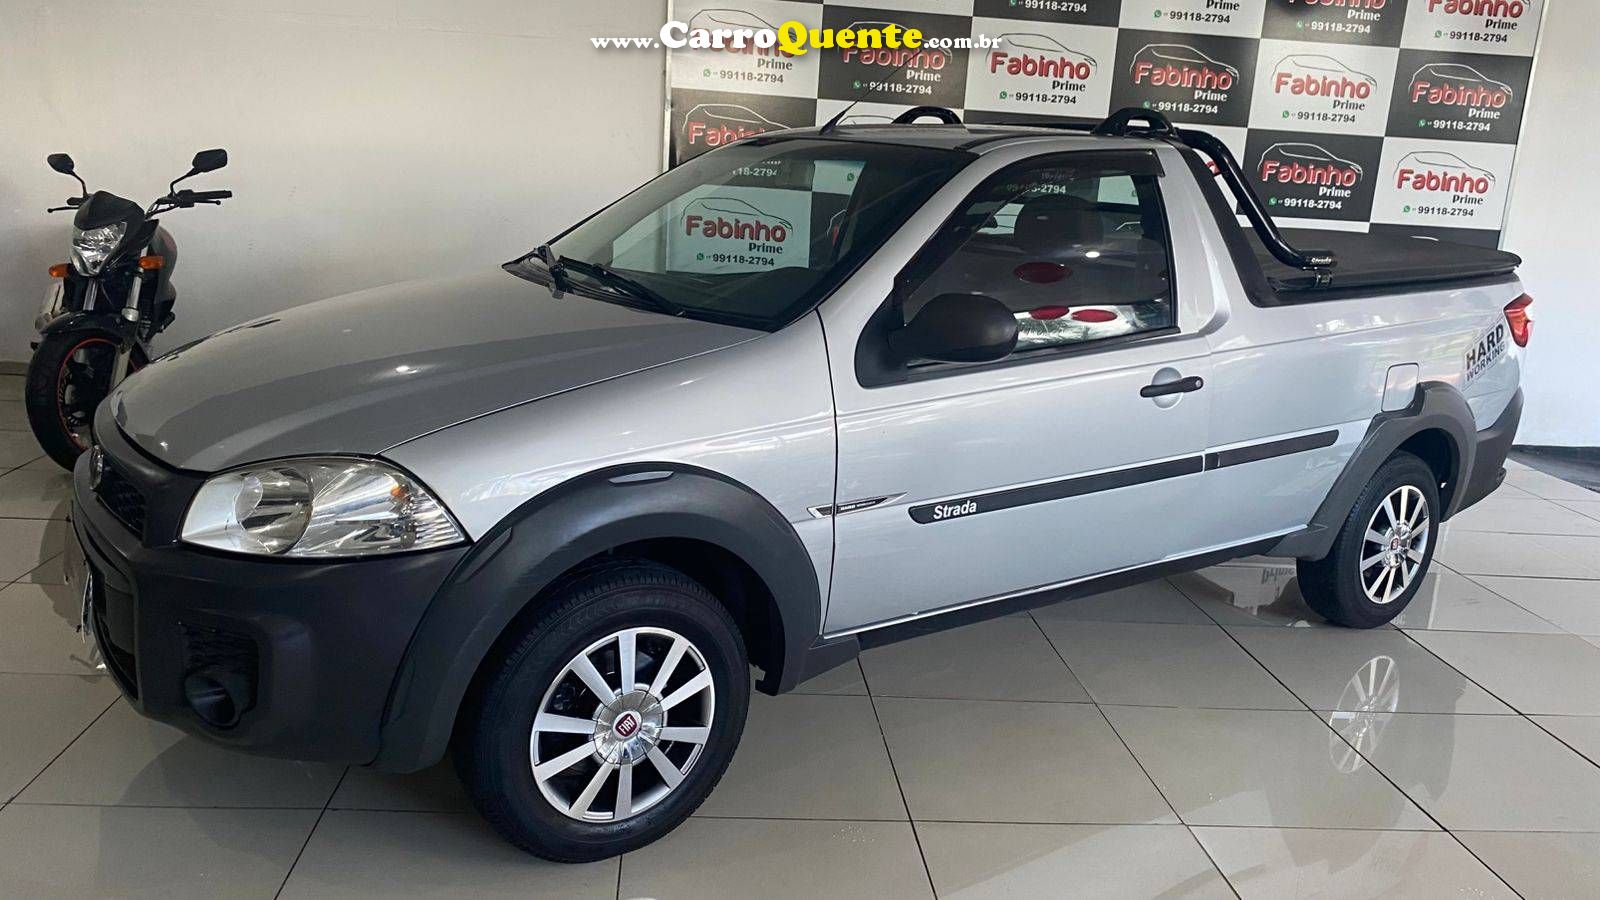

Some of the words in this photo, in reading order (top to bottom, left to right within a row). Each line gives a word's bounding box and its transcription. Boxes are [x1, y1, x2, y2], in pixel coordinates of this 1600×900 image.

[1025, 0, 1087, 13] 99118-2794
[1169, 11, 1231, 23] 99118-2794
[1347, 9, 1381, 21] Prime
[1311, 21, 1371, 33] 99118-2794
[1485, 19, 1518, 30] Prime
[1449, 31, 1508, 42] 99118-2794
[757, 58, 793, 70] Prime
[990, 51, 1091, 80] Fabinho
[719, 70, 784, 83] 99118-2794
[906, 69, 942, 82] Prime
[1134, 61, 1233, 90] Fabinho
[869, 82, 932, 95] 99118-2794
[1052, 80, 1086, 92] Prime
[1274, 72, 1371, 99] Fabinho
[1015, 92, 1077, 105] 99118-2794
[1194, 89, 1228, 102] Prime
[1411, 81, 1506, 108] Fabinho
[1158, 101, 1218, 114] 99118-2794
[1332, 99, 1365, 111] Prime
[1297, 111, 1356, 123] 99118-2794
[1468, 107, 1501, 119] Prime
[1433, 119, 1491, 131] 99118-2794
[1261, 160, 1357, 187] Fabinho
[1397, 168, 1490, 194] Fabinho
[1318, 186, 1351, 198] Prime
[1284, 197, 1342, 210] 99118-2794
[1452, 194, 1484, 205] Prime
[1417, 205, 1475, 217] 99118-2794
[685, 215, 786, 242] Fabinho
[749, 242, 783, 254] Prime
[712, 253, 775, 266] 99118-2794
[1466, 323, 1504, 370] HARD
[1466, 341, 1505, 381] WORKING
[933, 500, 977, 519] Strada
[618, 715, 635, 735] FIAT
